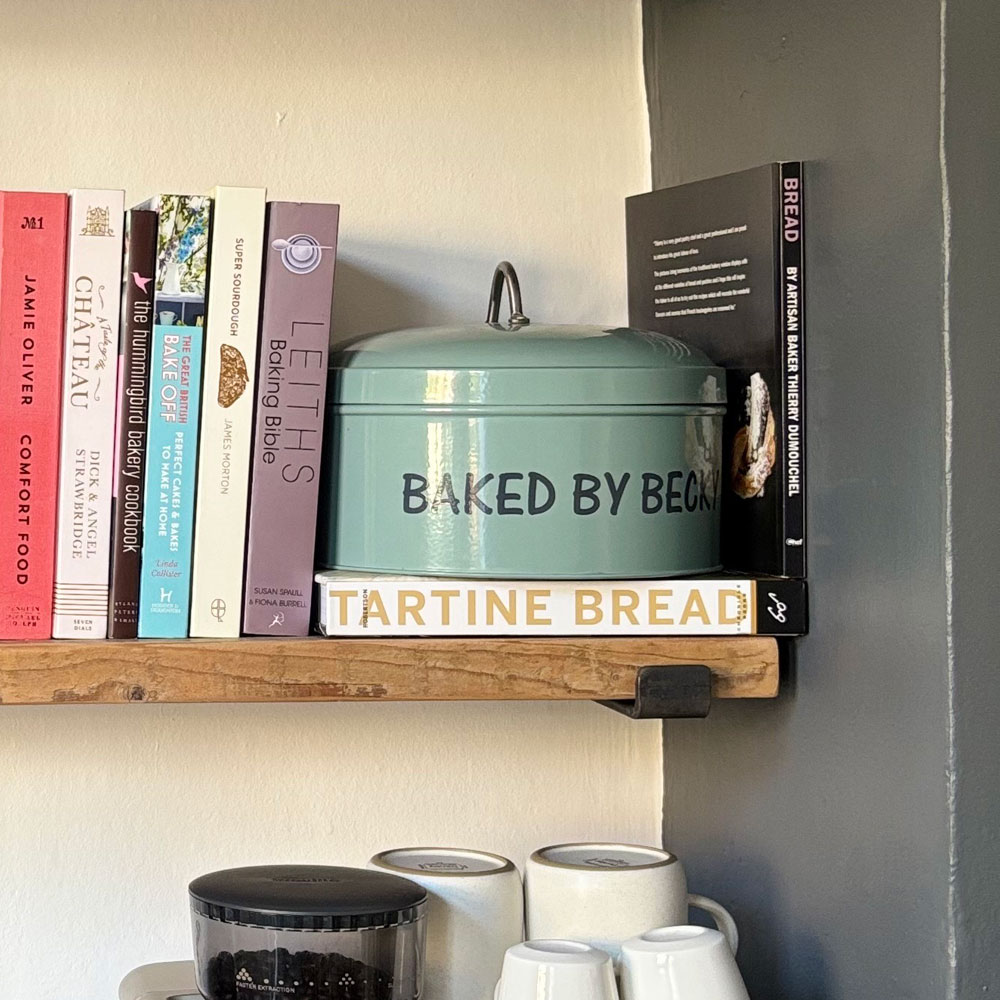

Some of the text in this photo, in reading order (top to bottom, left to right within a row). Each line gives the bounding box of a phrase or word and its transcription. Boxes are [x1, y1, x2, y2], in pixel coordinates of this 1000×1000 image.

[783, 177, 799, 243] BREAD
[21, 275, 36, 406] JAMIE OLIVER
[230, 237, 244, 337] SUPER SOURDOUGH
[70, 275, 96, 409] CHÂTEAU
[159, 333, 180, 424] BAKE OFF
[180, 356, 191, 388] GREAT
[786, 284, 800, 497] ARTISAN BAKER THIERRY DUMOUCHEL
[122, 300, 151, 553] the hummingbird bakery cookbook
[262, 339, 287, 465] Baking Bible
[281, 321, 325, 484] LEITHS
[16, 434, 32, 585] COMFORT FOOD
[72, 449, 86, 560] STRAWBRIDGE
[86, 451, 100, 559] DICK ANGEL
[170, 431, 184, 552] PERFECT CAKES BAKES
[220, 418, 233, 496] JAMES MORTON
[402, 468, 720, 517] BAKED BY BECKY
[254, 587, 304, 597] SUSAN SPAULL
[255, 599, 277, 607] FIONA
[328, 588, 553, 628] TARTINE
[574, 588, 747, 628] BREAD
